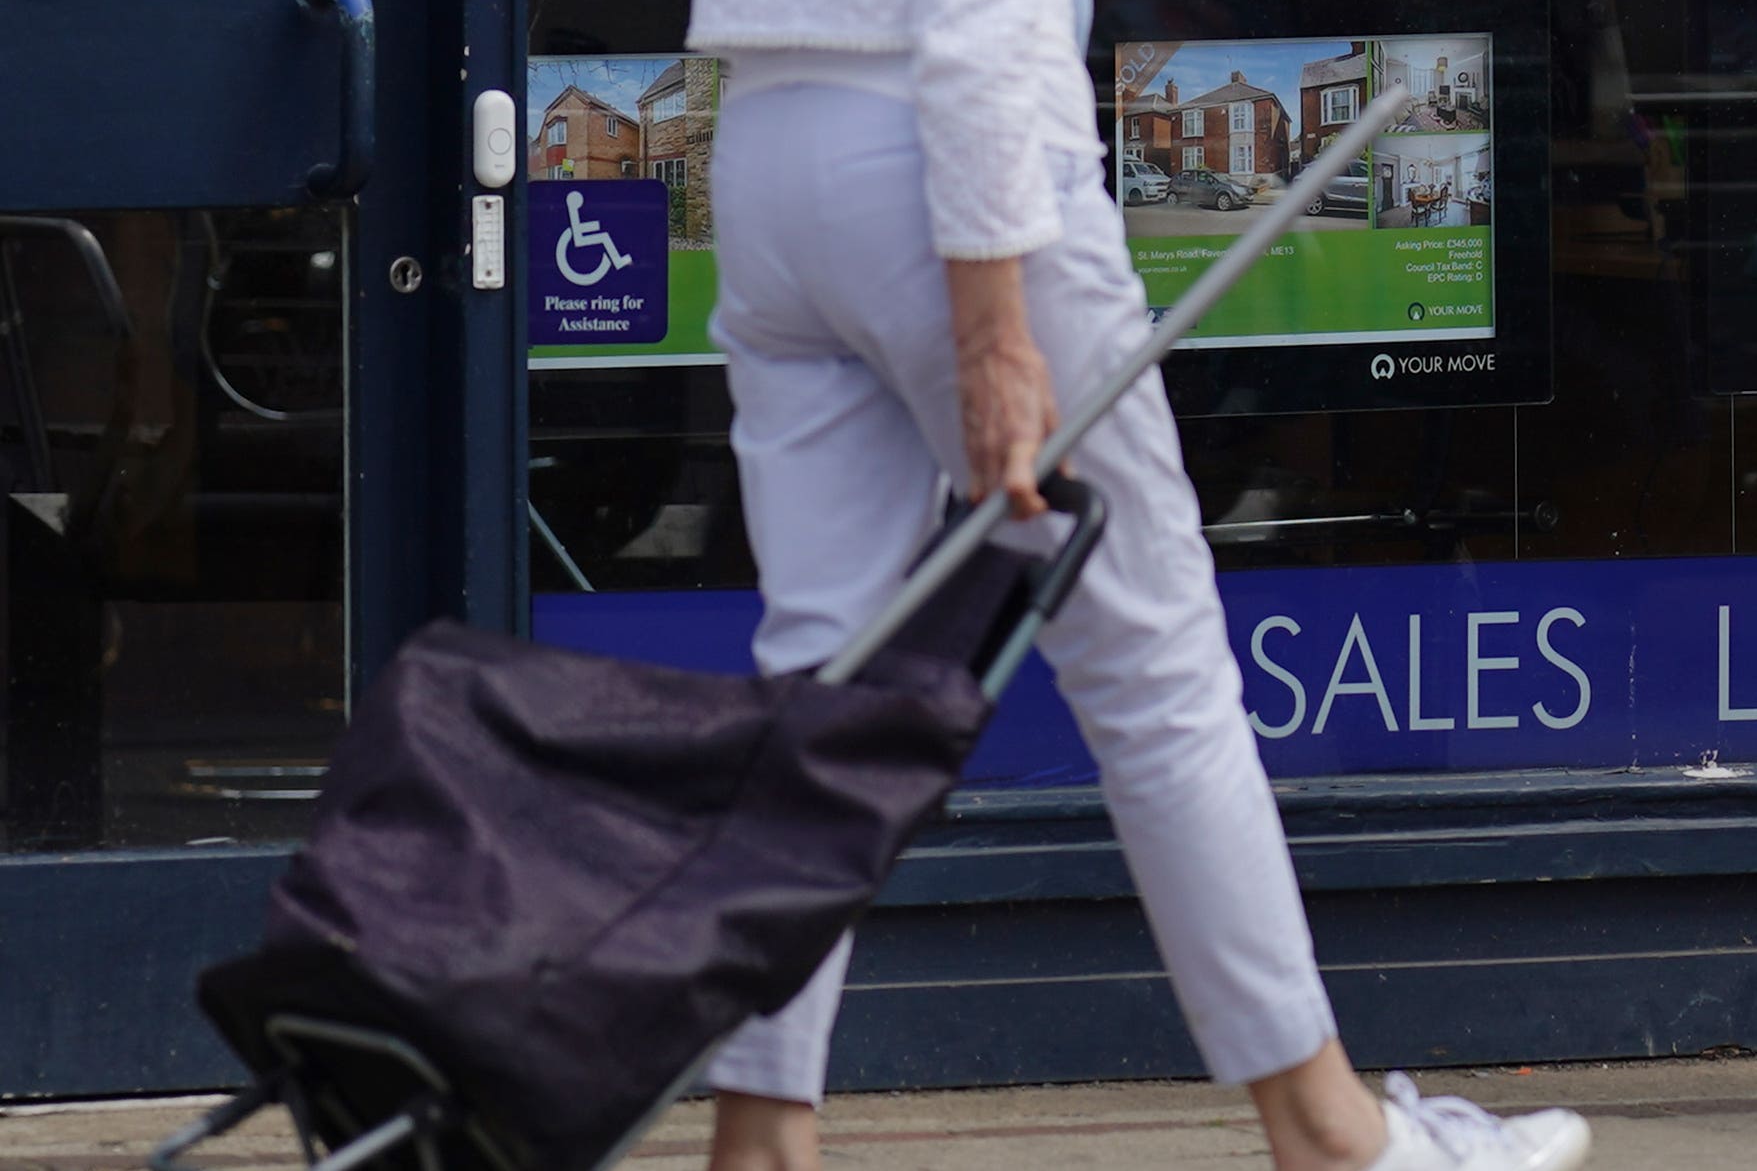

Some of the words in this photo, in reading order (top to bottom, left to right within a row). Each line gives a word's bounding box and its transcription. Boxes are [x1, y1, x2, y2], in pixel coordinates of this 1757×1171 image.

[1271, 246, 1294, 256] ME13
[1396, 240, 1422, 251] Asking
[1449, 250, 1482, 258] Freehold
[1406, 263, 1434, 272] Council
[1436, 262, 1451, 271] Tax
[1476, 260, 1482, 270] C
[1428, 273, 1446, 282] EPC
[1447, 273, 1474, 283] Rating:
[1476, 272, 1482, 281] D
[545, 296, 588, 310] Please
[591, 294, 620, 314] ring
[622, 294, 644, 310] for
[1429, 306, 1454, 316] YOUR
[1456, 305, 1482, 315] MOVE
[558, 316, 630, 332] Assistance
[1399, 356, 1443, 374] YOUR
[1448, 354, 1496, 372] MOVE
[1248, 607, 1591, 739] SALES
